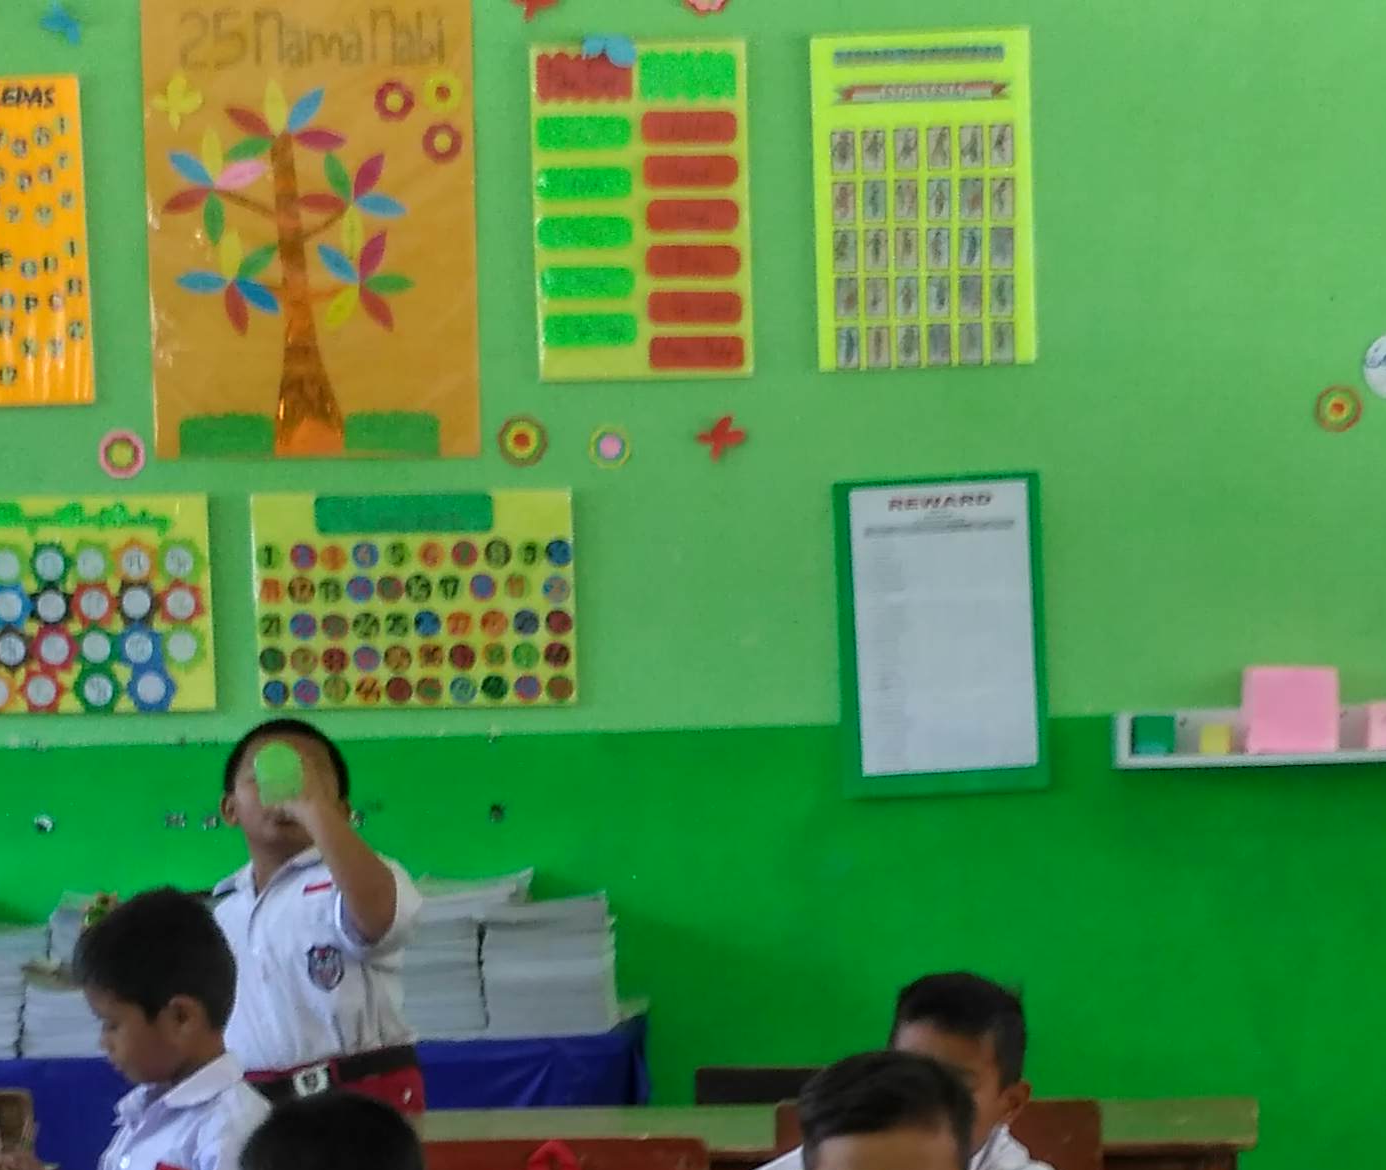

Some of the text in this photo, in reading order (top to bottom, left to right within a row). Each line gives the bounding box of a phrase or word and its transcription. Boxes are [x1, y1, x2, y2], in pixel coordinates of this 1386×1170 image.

[179, 5, 445, 71] 25 Nama Nabi
[888, 492, 994, 512] REWARD
